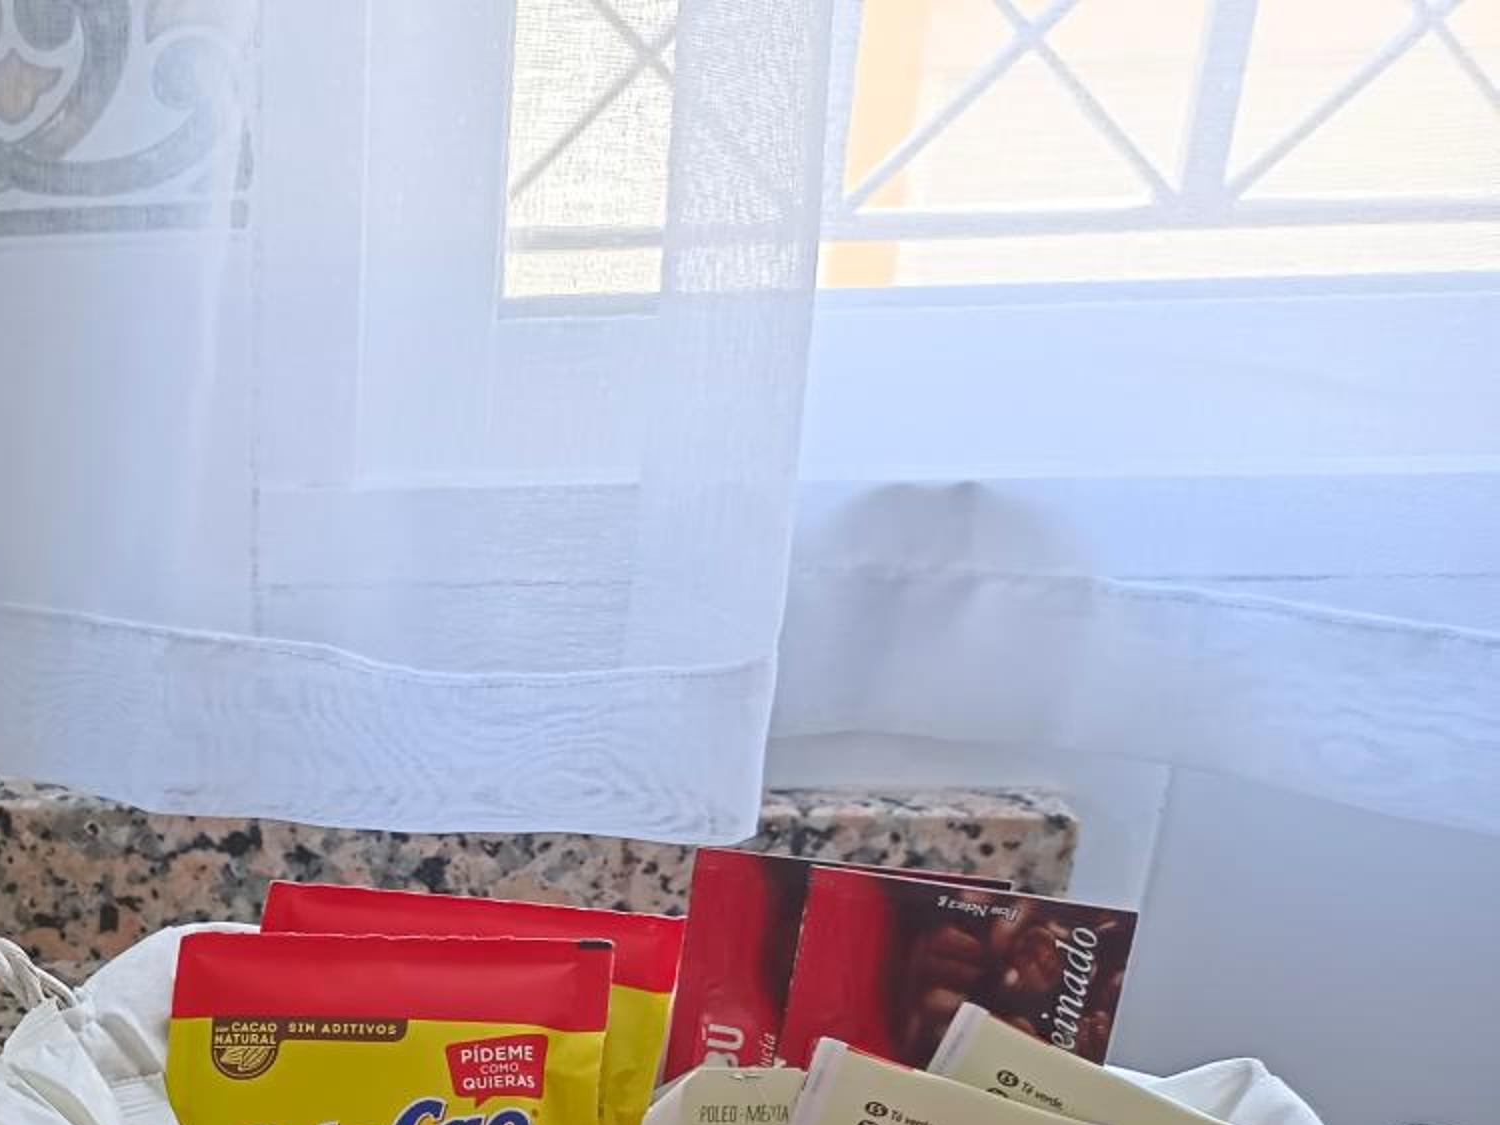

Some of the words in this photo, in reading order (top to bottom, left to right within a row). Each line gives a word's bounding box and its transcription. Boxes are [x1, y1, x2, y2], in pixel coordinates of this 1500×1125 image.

[231, 1021, 277, 1033] CACAO
[287, 1021, 315, 1033] SIN
[321, 1022, 397, 1035] ADITIVOS
[214, 1033, 277, 1045] NATURAL
[461, 1045, 533, 1064] PÍDEME
[480, 1062, 519, 1075] COMO
[463, 1074, 535, 1091] QUIERAS
